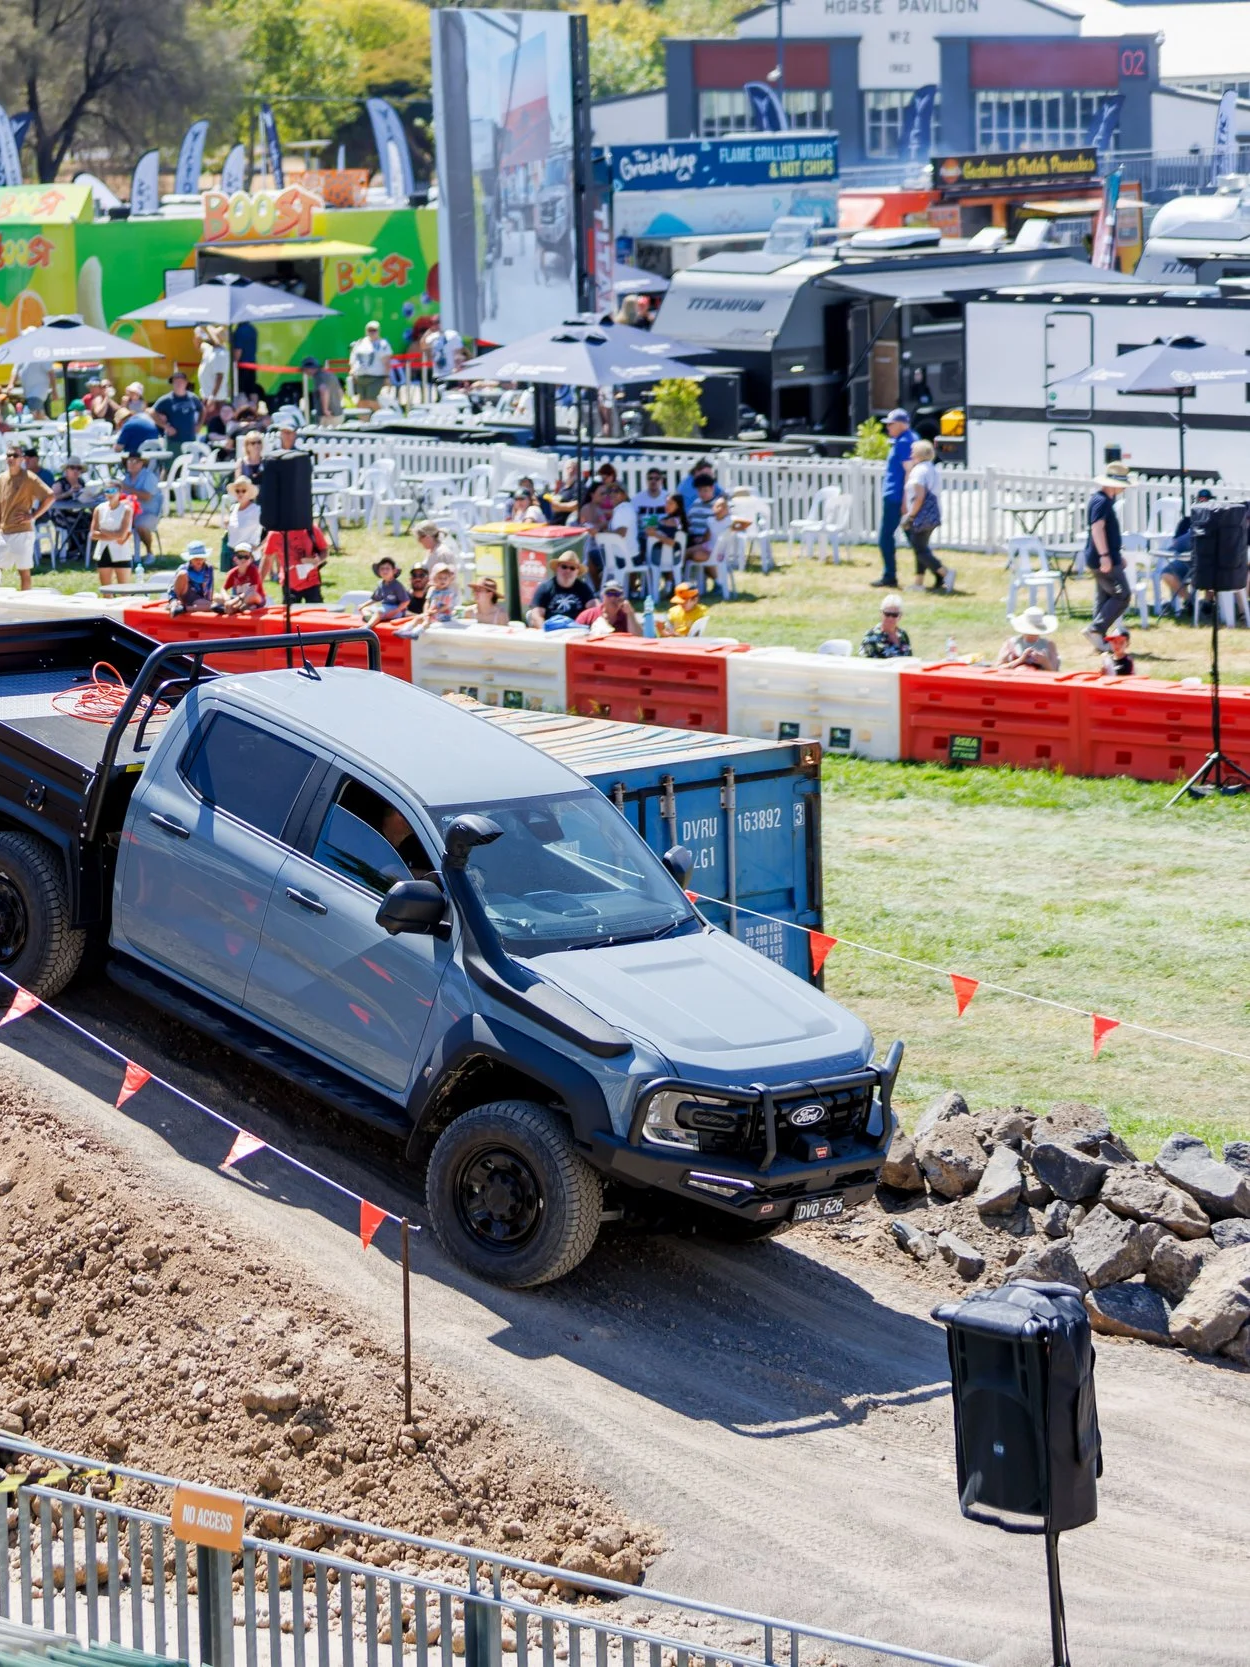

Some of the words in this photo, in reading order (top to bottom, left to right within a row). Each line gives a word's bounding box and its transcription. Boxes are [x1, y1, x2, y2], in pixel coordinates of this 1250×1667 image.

[824, 0, 883, 15] HORSE
[898, 0, 979, 14] PAVILION
[1121, 51, 1145, 76] 02
[719, 147, 753, 163] FLAME
[754, 145, 796, 161] GRILLED
[798, 143, 834, 159] WRAPS
[769, 162, 779, 179] &
[780, 160, 800, 177] HOT
[803, 159, 835, 176] CHIPS
[1007, 158, 1016, 176] &
[204, 188, 323, 242] BOOST
[336, 252, 414, 293] BOOST
[686, 297, 766, 312] TITANIUM
[683, 817, 717, 841] DVRU
[737, 808, 782, 833] 163892
[794, 803, 804, 825] 3
[769, 922, 783, 933] KGS
[797, 1108, 820, 1123] Ford
[182, 1504, 196, 1525] NO
[197, 1508, 234, 1534] ACCESS
